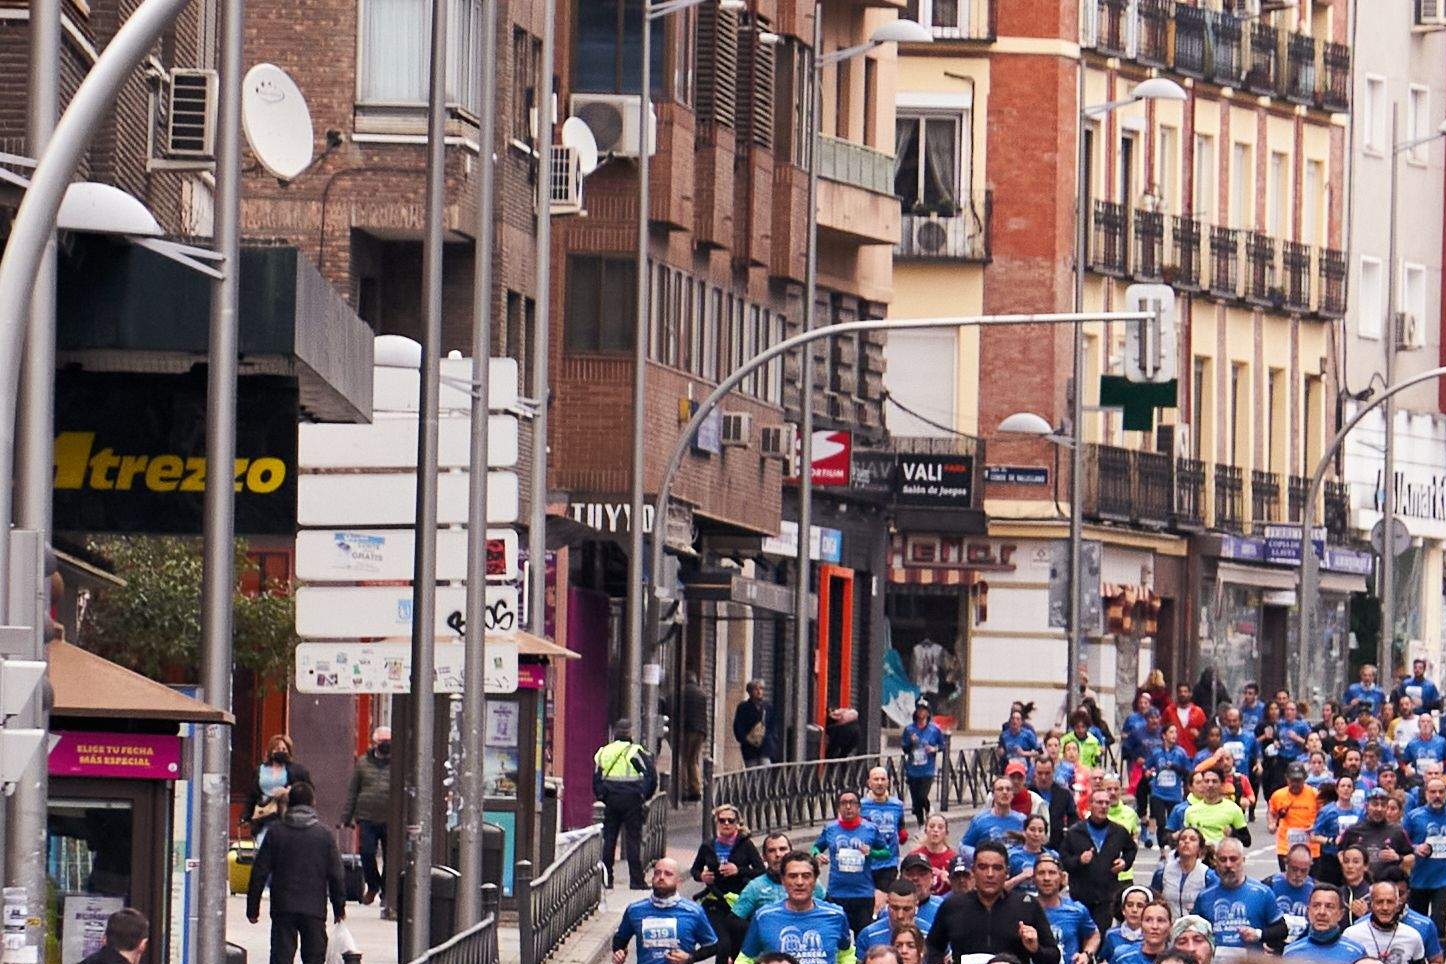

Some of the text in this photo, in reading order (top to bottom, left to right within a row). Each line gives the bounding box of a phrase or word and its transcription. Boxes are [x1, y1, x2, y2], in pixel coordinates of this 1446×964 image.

[903, 462, 942, 481] VALI
[107, 746, 119, 754] TU
[121, 746, 154, 756] FECHA
[104, 756, 151, 766] ESPECIAL
[795, 950, 828, 958] ARRERA
